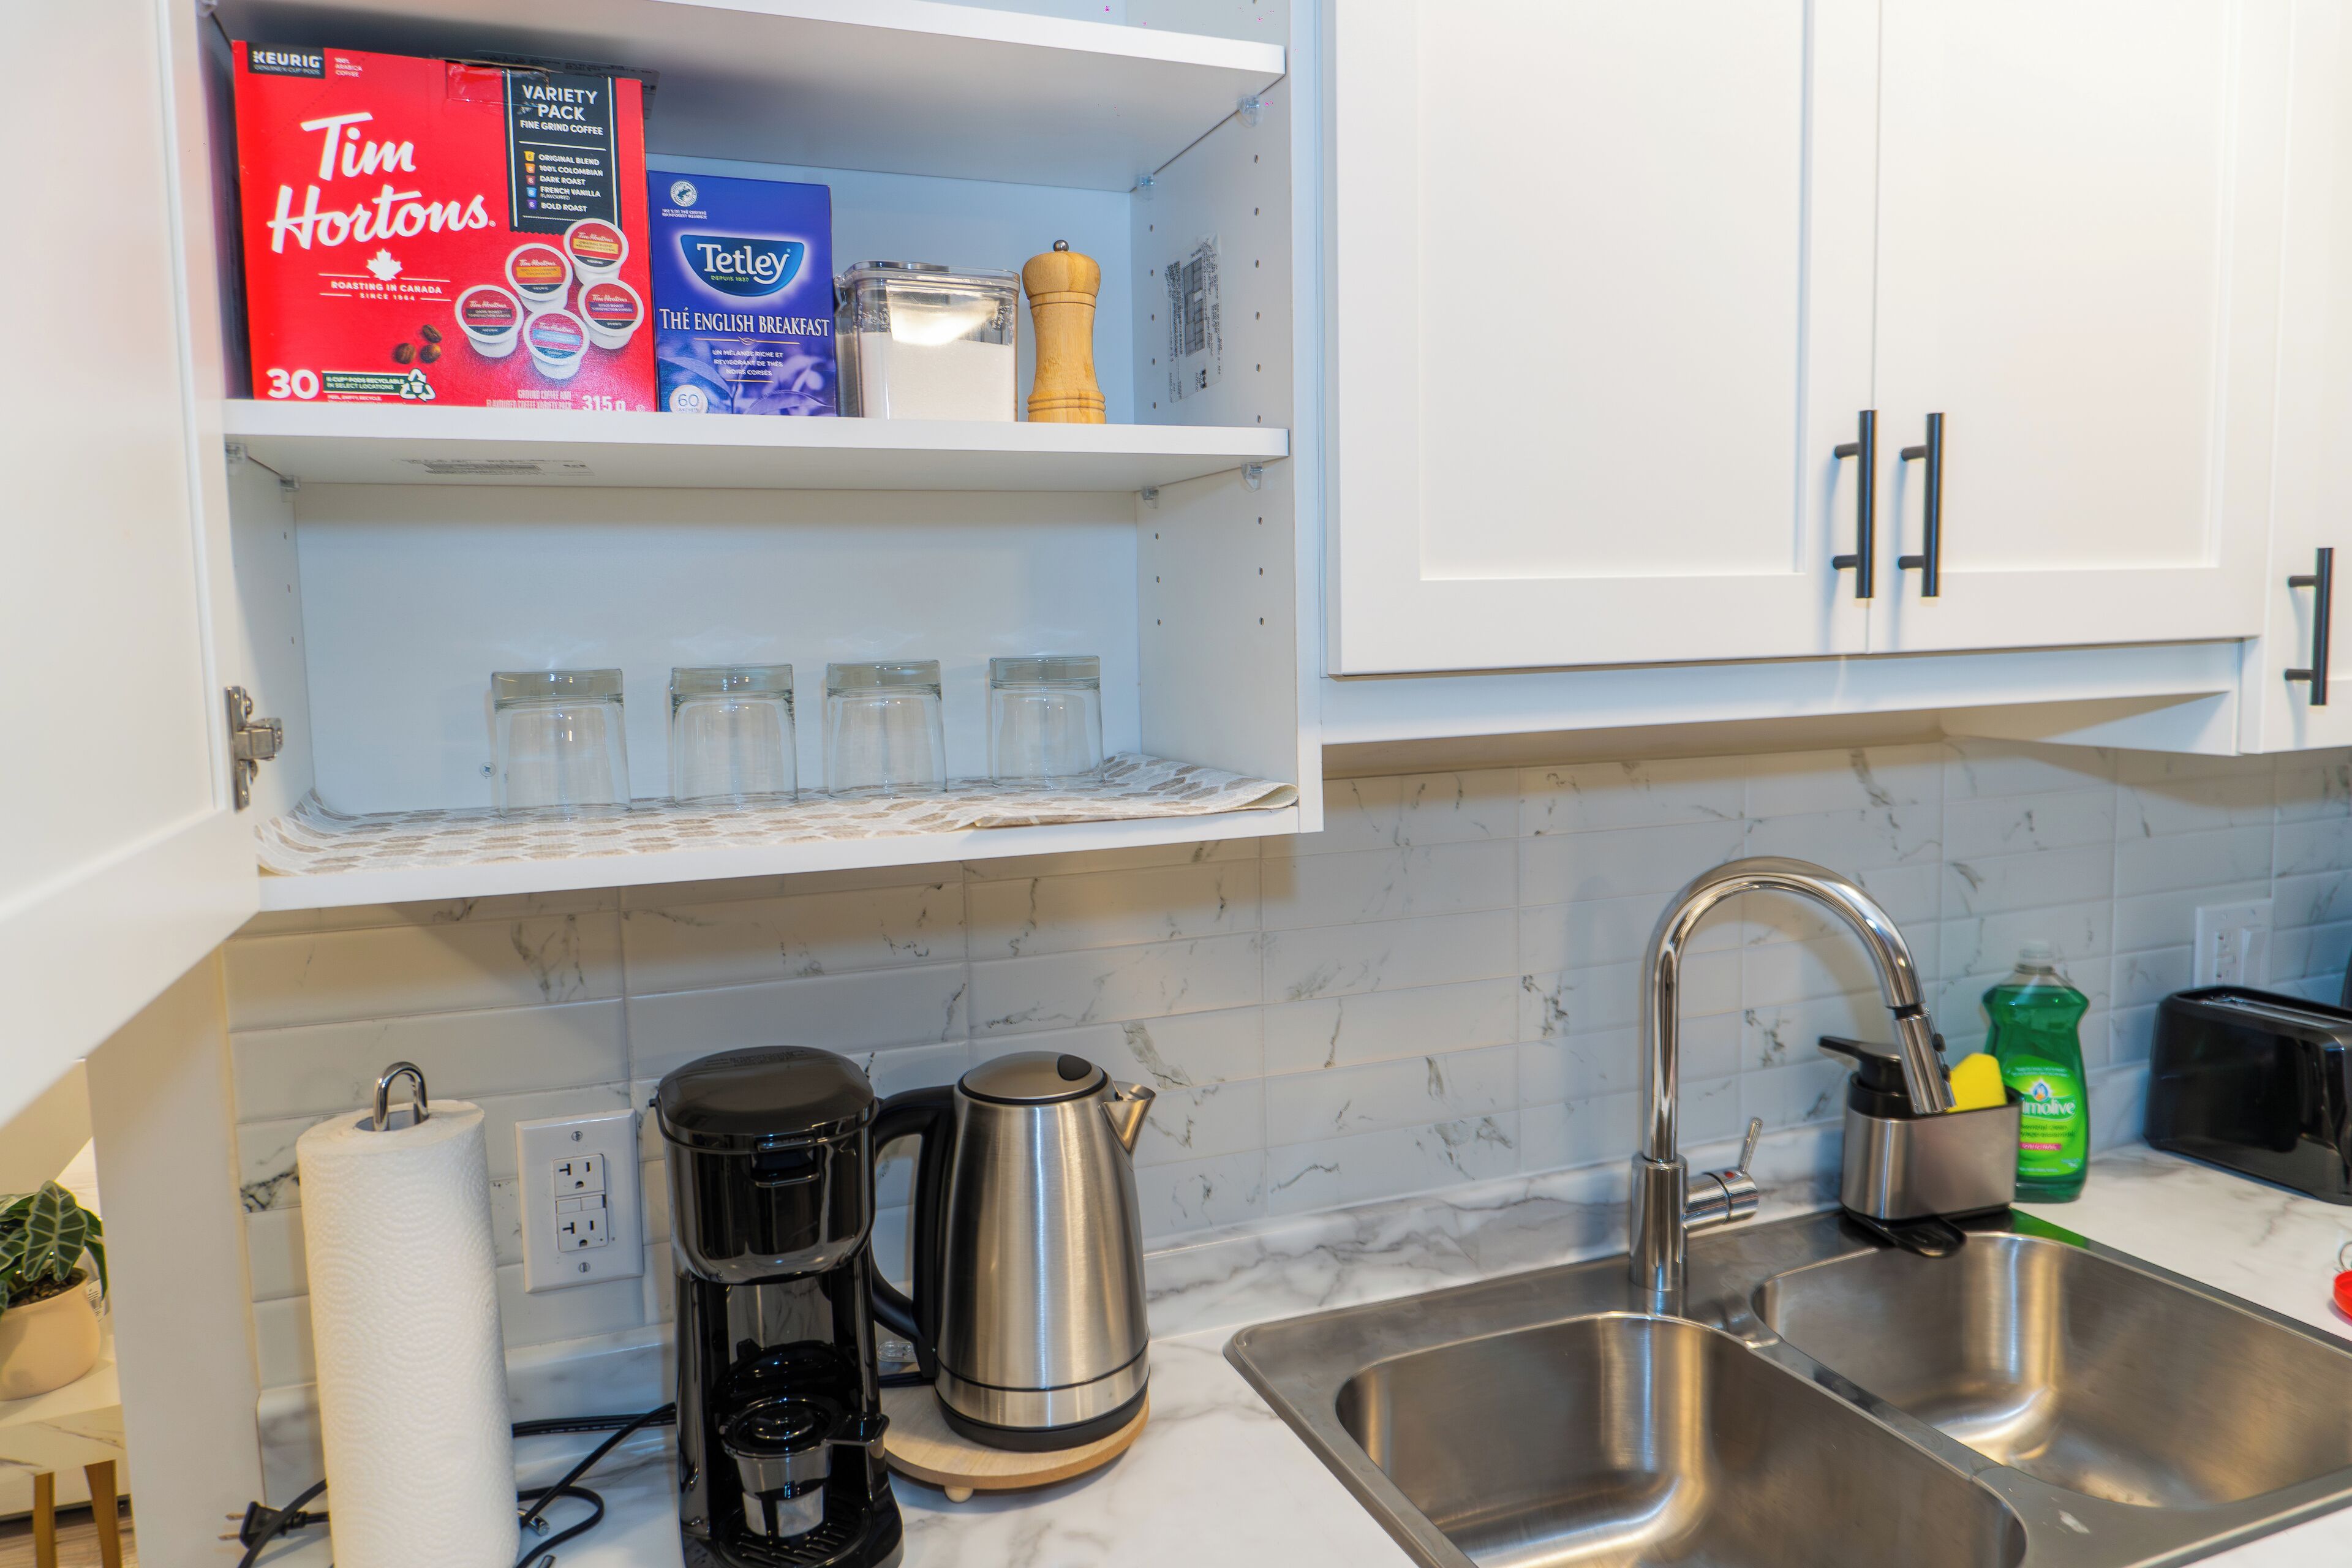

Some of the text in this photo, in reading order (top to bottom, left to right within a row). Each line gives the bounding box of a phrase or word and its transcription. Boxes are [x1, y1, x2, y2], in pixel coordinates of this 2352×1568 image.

[252, 51, 321, 69] KEURIG
[522, 85, 598, 105] VARIETY
[538, 103, 586, 121] PACK
[520, 119, 603, 135] FINE GRIND COFFEE
[300, 112, 417, 181] Tim
[538, 154, 575, 164] ORIGINAL
[557, 167, 603, 176] COLOMBIAN
[561, 177, 586, 186] ROAST
[540, 186, 570, 195] FRENCH
[570, 189, 601, 197] VANILLA
[266, 184, 489, 254] Hortons
[696, 243, 790, 285] Tetley
[331, 281, 383, 291] ROASTING
[399, 285, 442, 294] CANADA
[658, 306, 830, 337] THÉ ENGLISH BREAKFAST
[266, 368, 320, 399] 30
[582, 395, 612, 412] 315
[678, 394, 699, 407] 60
[2022, 1099, 2076, 1115] lmolive
